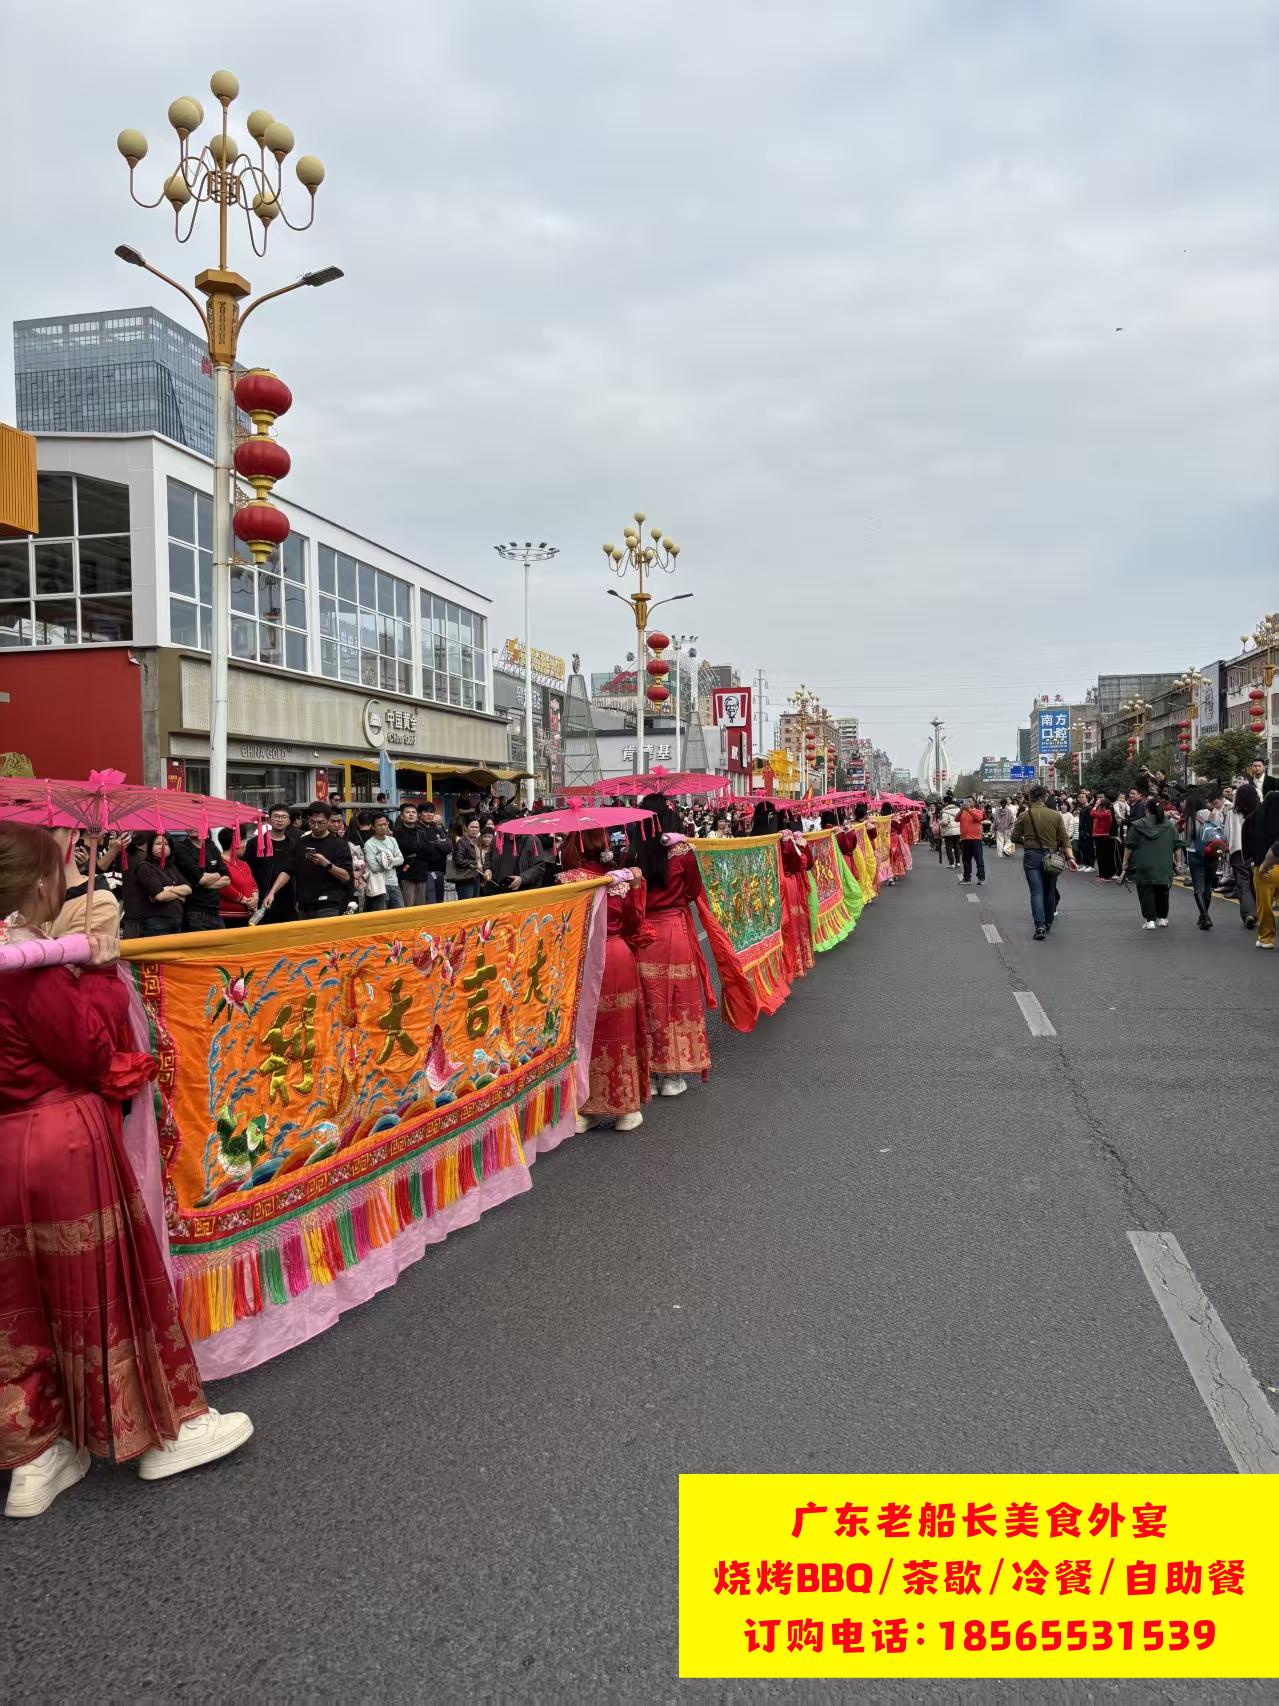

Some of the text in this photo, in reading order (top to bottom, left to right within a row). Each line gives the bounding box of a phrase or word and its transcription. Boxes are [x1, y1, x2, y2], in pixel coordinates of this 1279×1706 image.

[385, 709, 417, 732] 中国黄金
[1040, 714, 1067, 727] 南方
[1041, 727, 1067, 739] 口腔
[241, 745, 287, 760] CHINA GOLD
